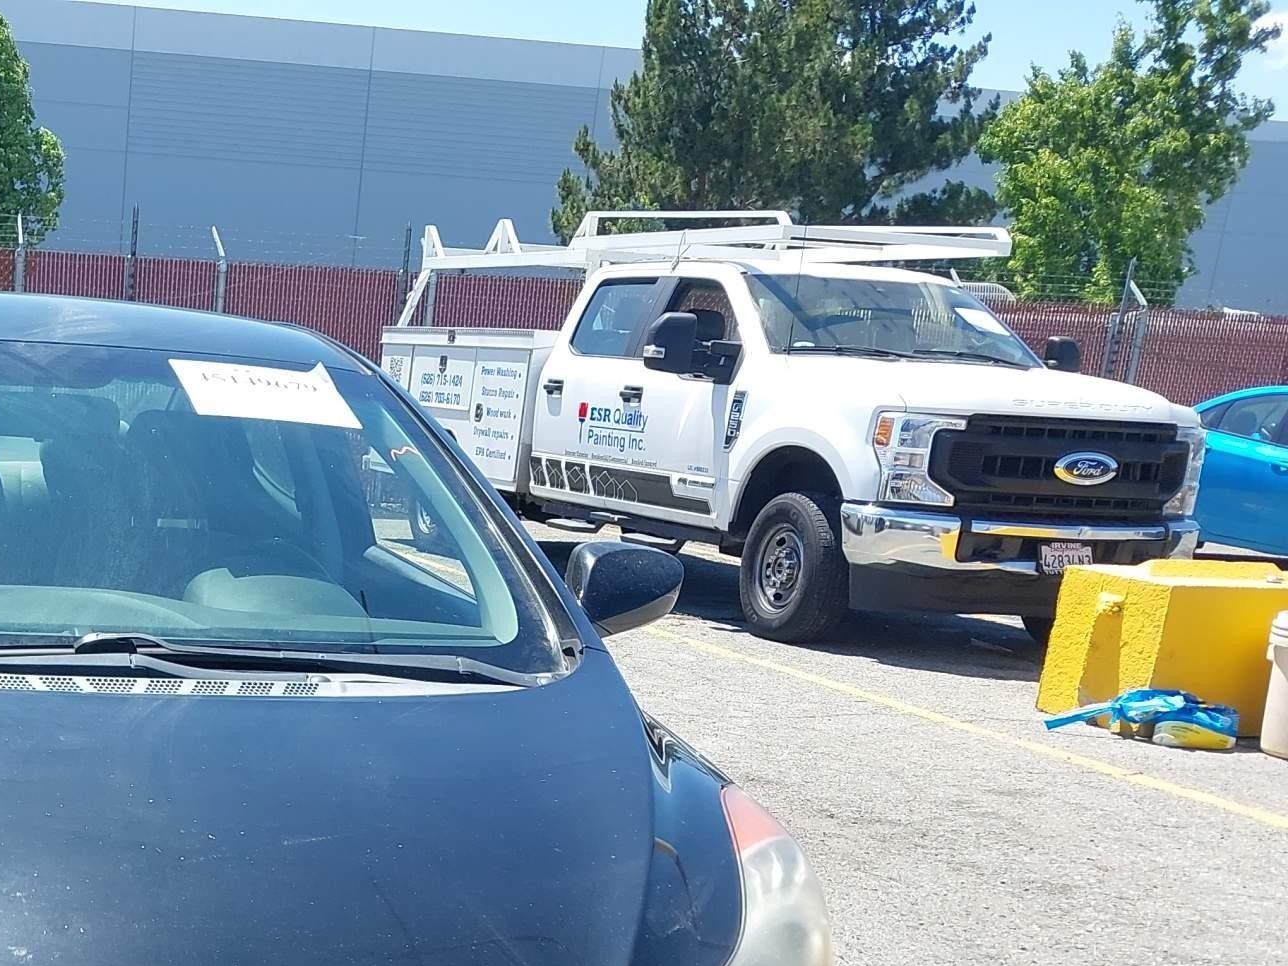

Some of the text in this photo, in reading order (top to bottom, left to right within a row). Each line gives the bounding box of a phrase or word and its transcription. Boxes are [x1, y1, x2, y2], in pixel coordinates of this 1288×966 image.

[590, 407, 648, 431] ESR Quality
[587, 429, 646, 452] Painting Inc.
[1072, 460, 1103, 476] Ford
